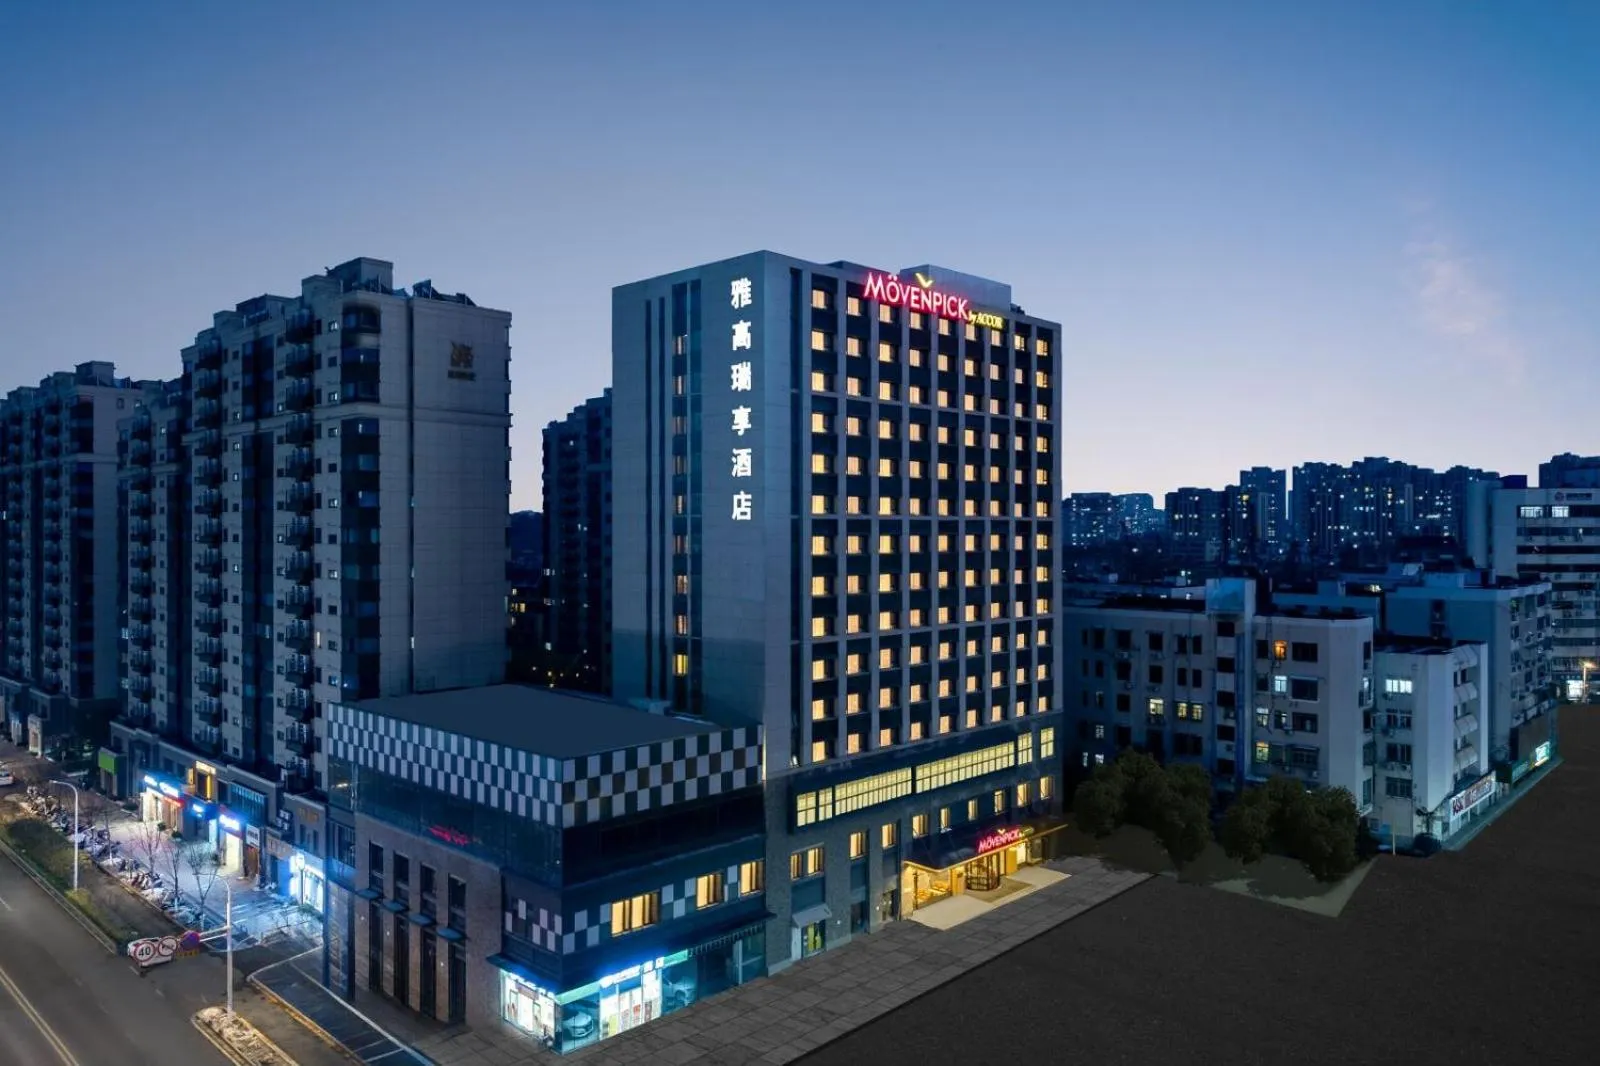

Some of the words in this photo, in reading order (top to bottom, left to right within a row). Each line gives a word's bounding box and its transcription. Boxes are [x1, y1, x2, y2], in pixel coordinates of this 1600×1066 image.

[863, 272, 970, 319] MÖVENPICK
[730, 277, 752, 521] 雅高瑞享酒店
[138, 946, 151, 957] 40
